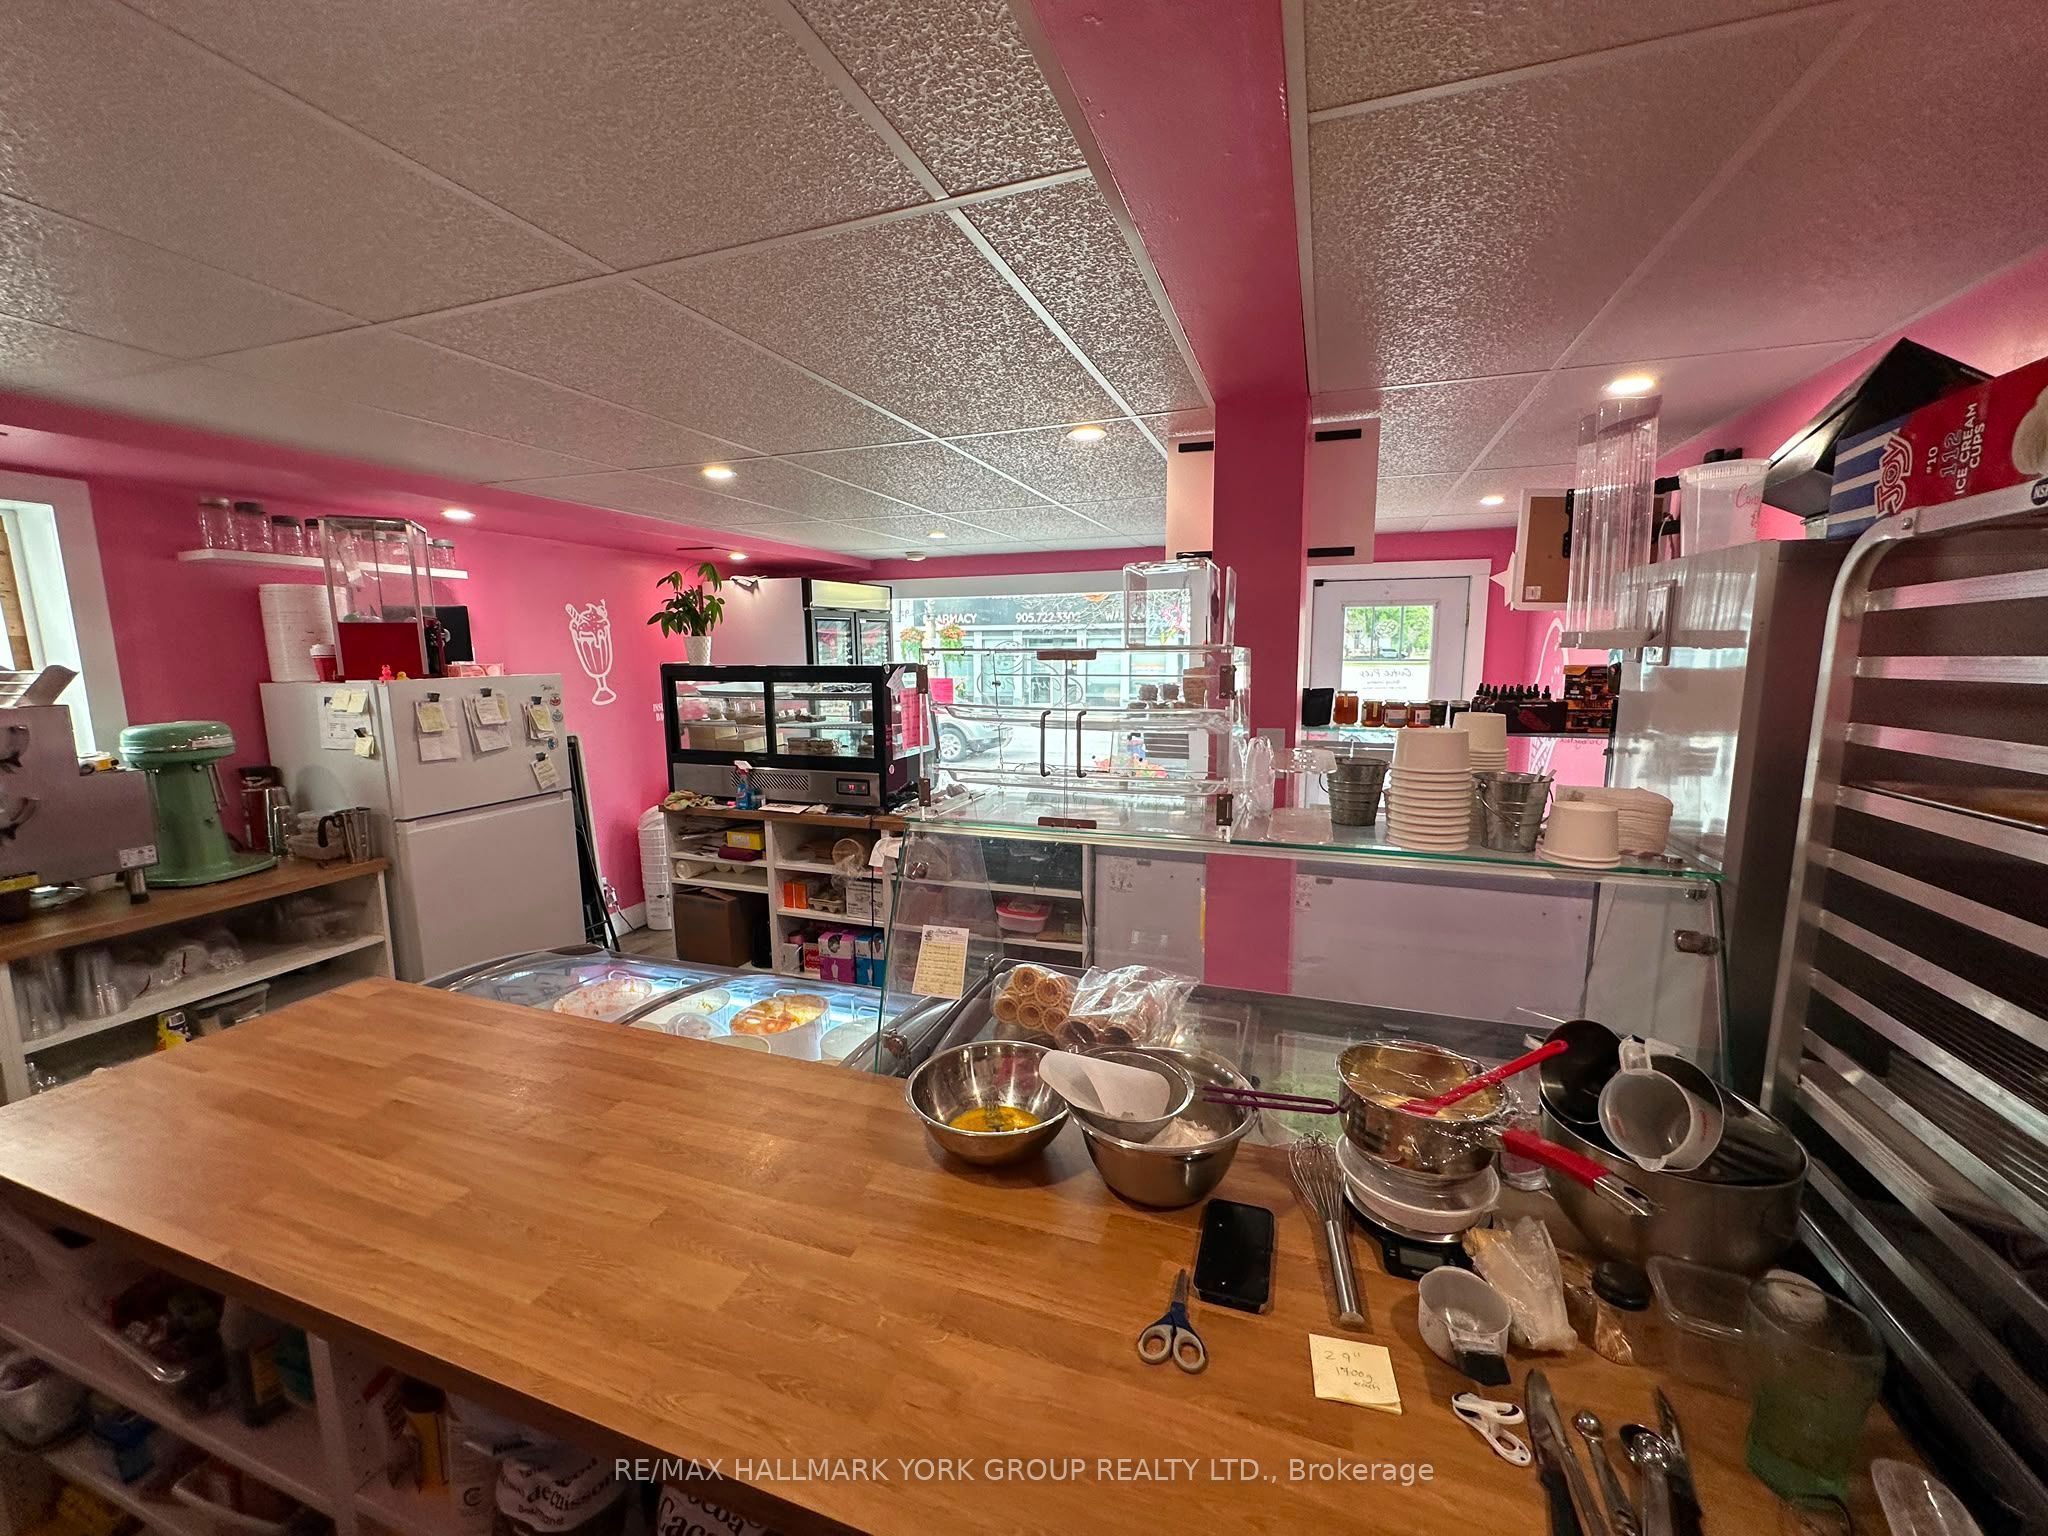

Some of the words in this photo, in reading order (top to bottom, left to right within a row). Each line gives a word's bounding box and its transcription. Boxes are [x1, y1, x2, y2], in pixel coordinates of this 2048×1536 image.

[1939, 429, 1963, 479] 112
[1960, 402, 1979, 464] CREAM
[1969, 422, 1985, 468] CUPS
[1954, 467, 1968, 496] ICE
[923, 612, 978, 625] ARMACY
